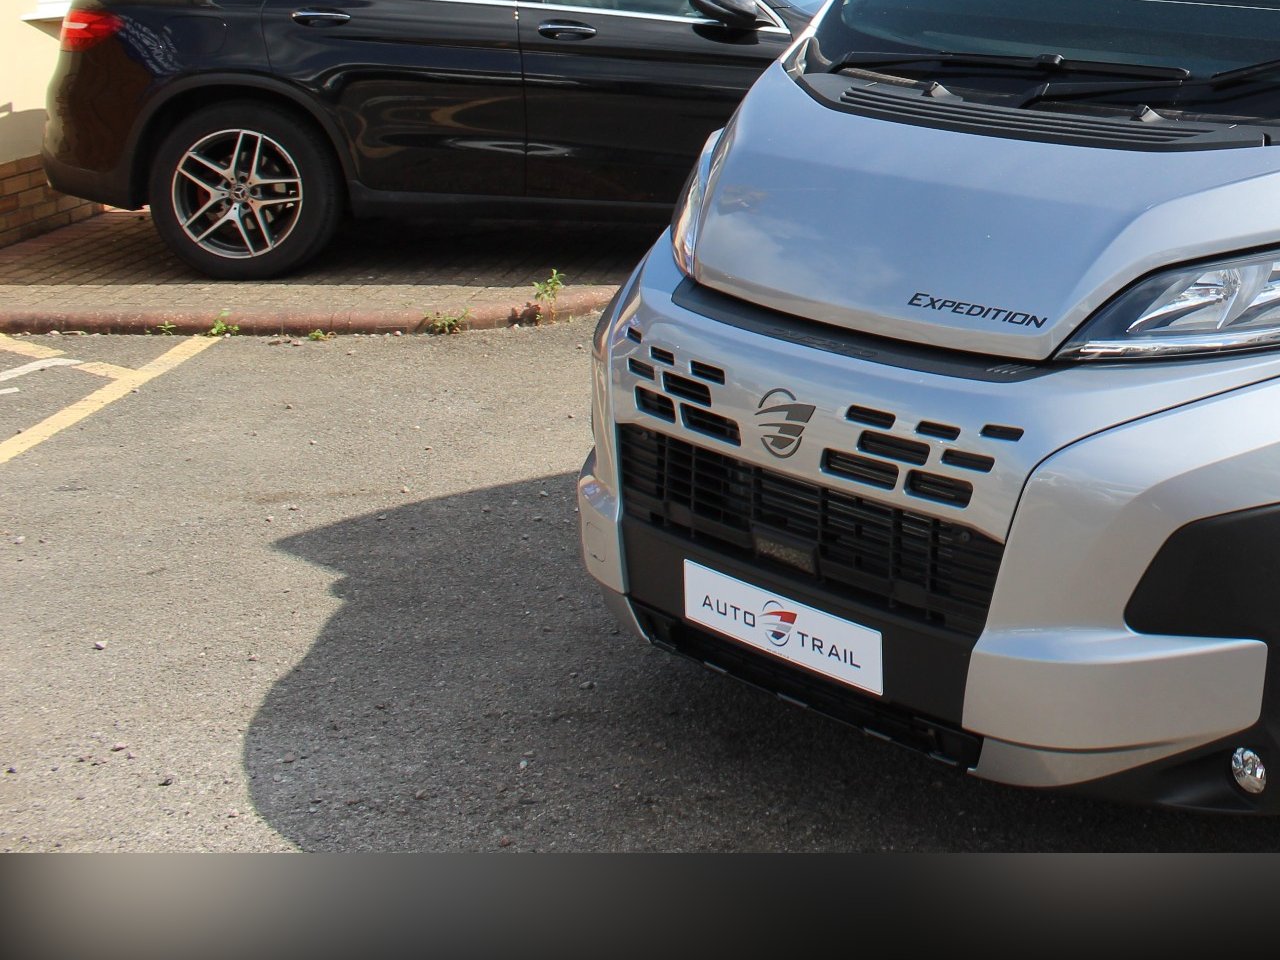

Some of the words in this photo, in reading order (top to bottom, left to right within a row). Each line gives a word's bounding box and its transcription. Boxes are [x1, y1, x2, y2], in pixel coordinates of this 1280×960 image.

[907, 292, 1048, 329] EXPEDITION
[702, 595, 756, 628] AUTO
[797, 631, 861, 669] TRAIL
